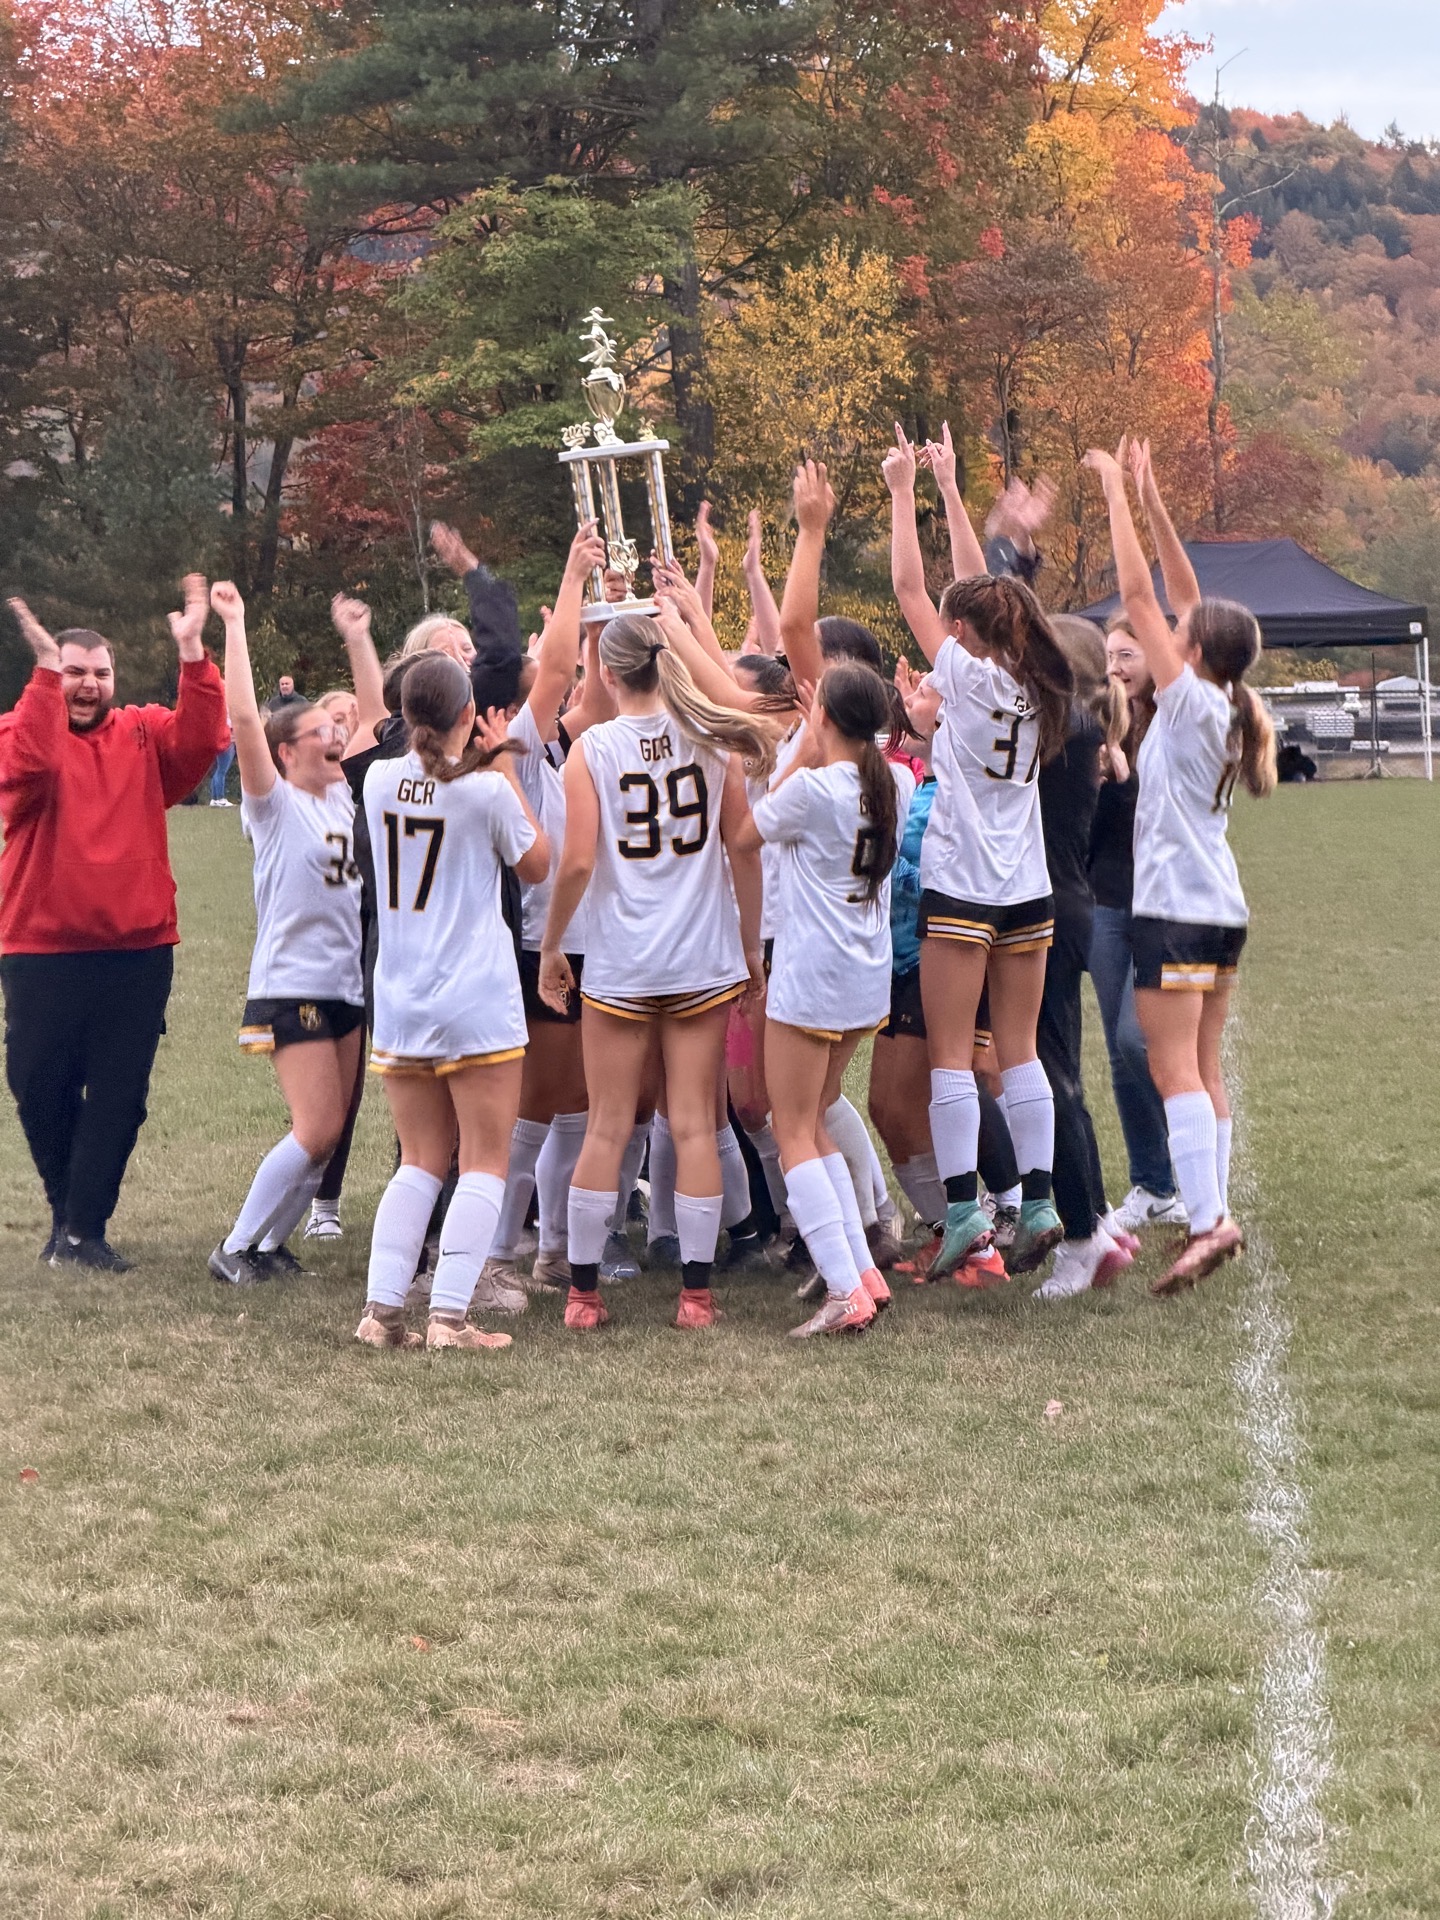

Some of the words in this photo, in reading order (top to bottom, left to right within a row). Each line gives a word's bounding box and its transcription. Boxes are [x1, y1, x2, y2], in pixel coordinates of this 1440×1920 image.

[639, 735, 674, 762] GCR
[396, 778, 436, 805] GCR
[617, 762, 708, 861] 39
[383, 811, 446, 912] 17
